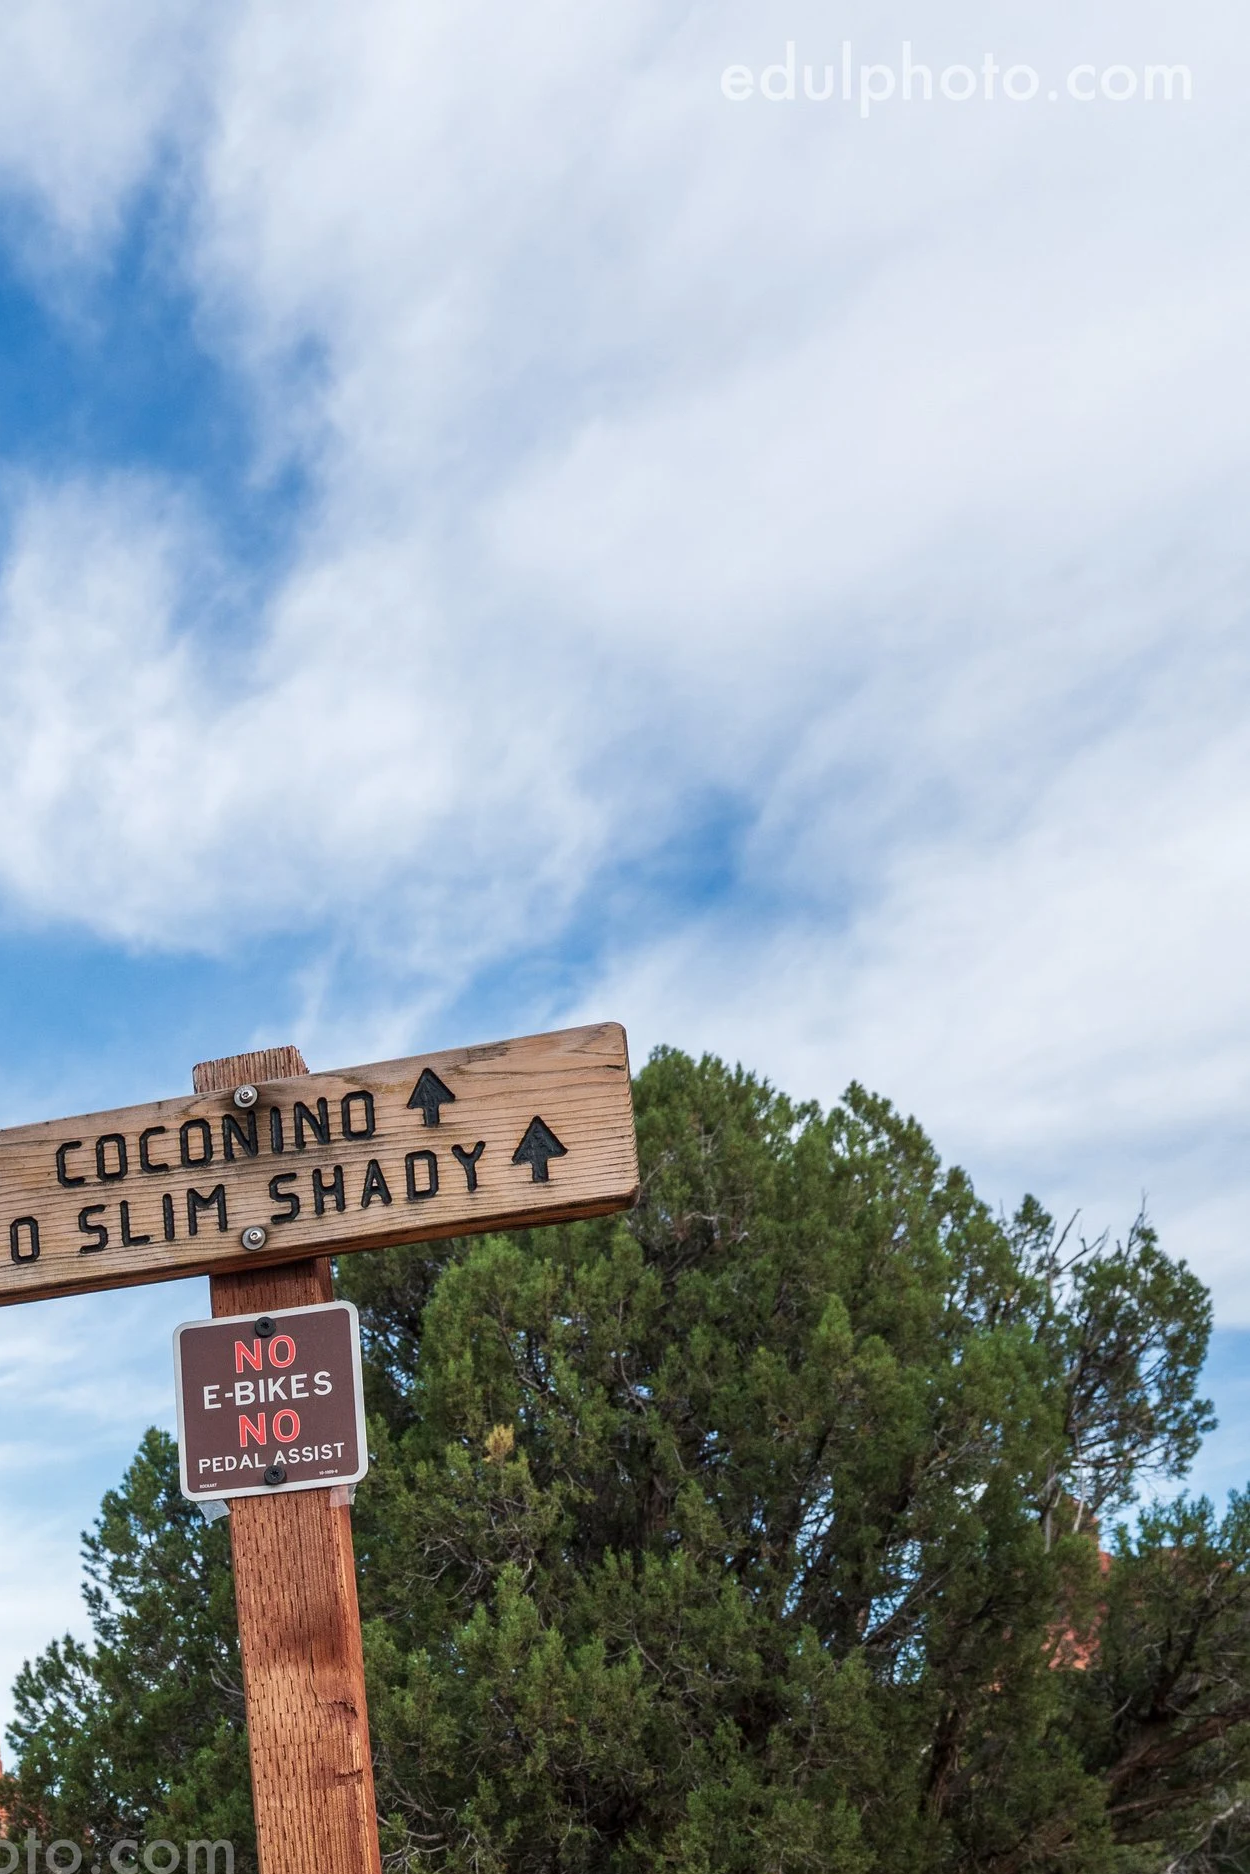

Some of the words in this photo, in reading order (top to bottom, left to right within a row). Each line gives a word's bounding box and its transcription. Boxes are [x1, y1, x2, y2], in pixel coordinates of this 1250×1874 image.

[56, 1090, 375, 1188] COCONINO
[79, 1184, 228, 1254] SLIM
[269, 1141, 487, 1225] SHADY
[234, 1334, 297, 1374] NO
[203, 1370, 333, 1410] E-BIKES
[238, 1408, 301, 1448] NO
[198, 1453, 267, 1474] PEDAL
[273, 1442, 345, 1466] ASSIST
